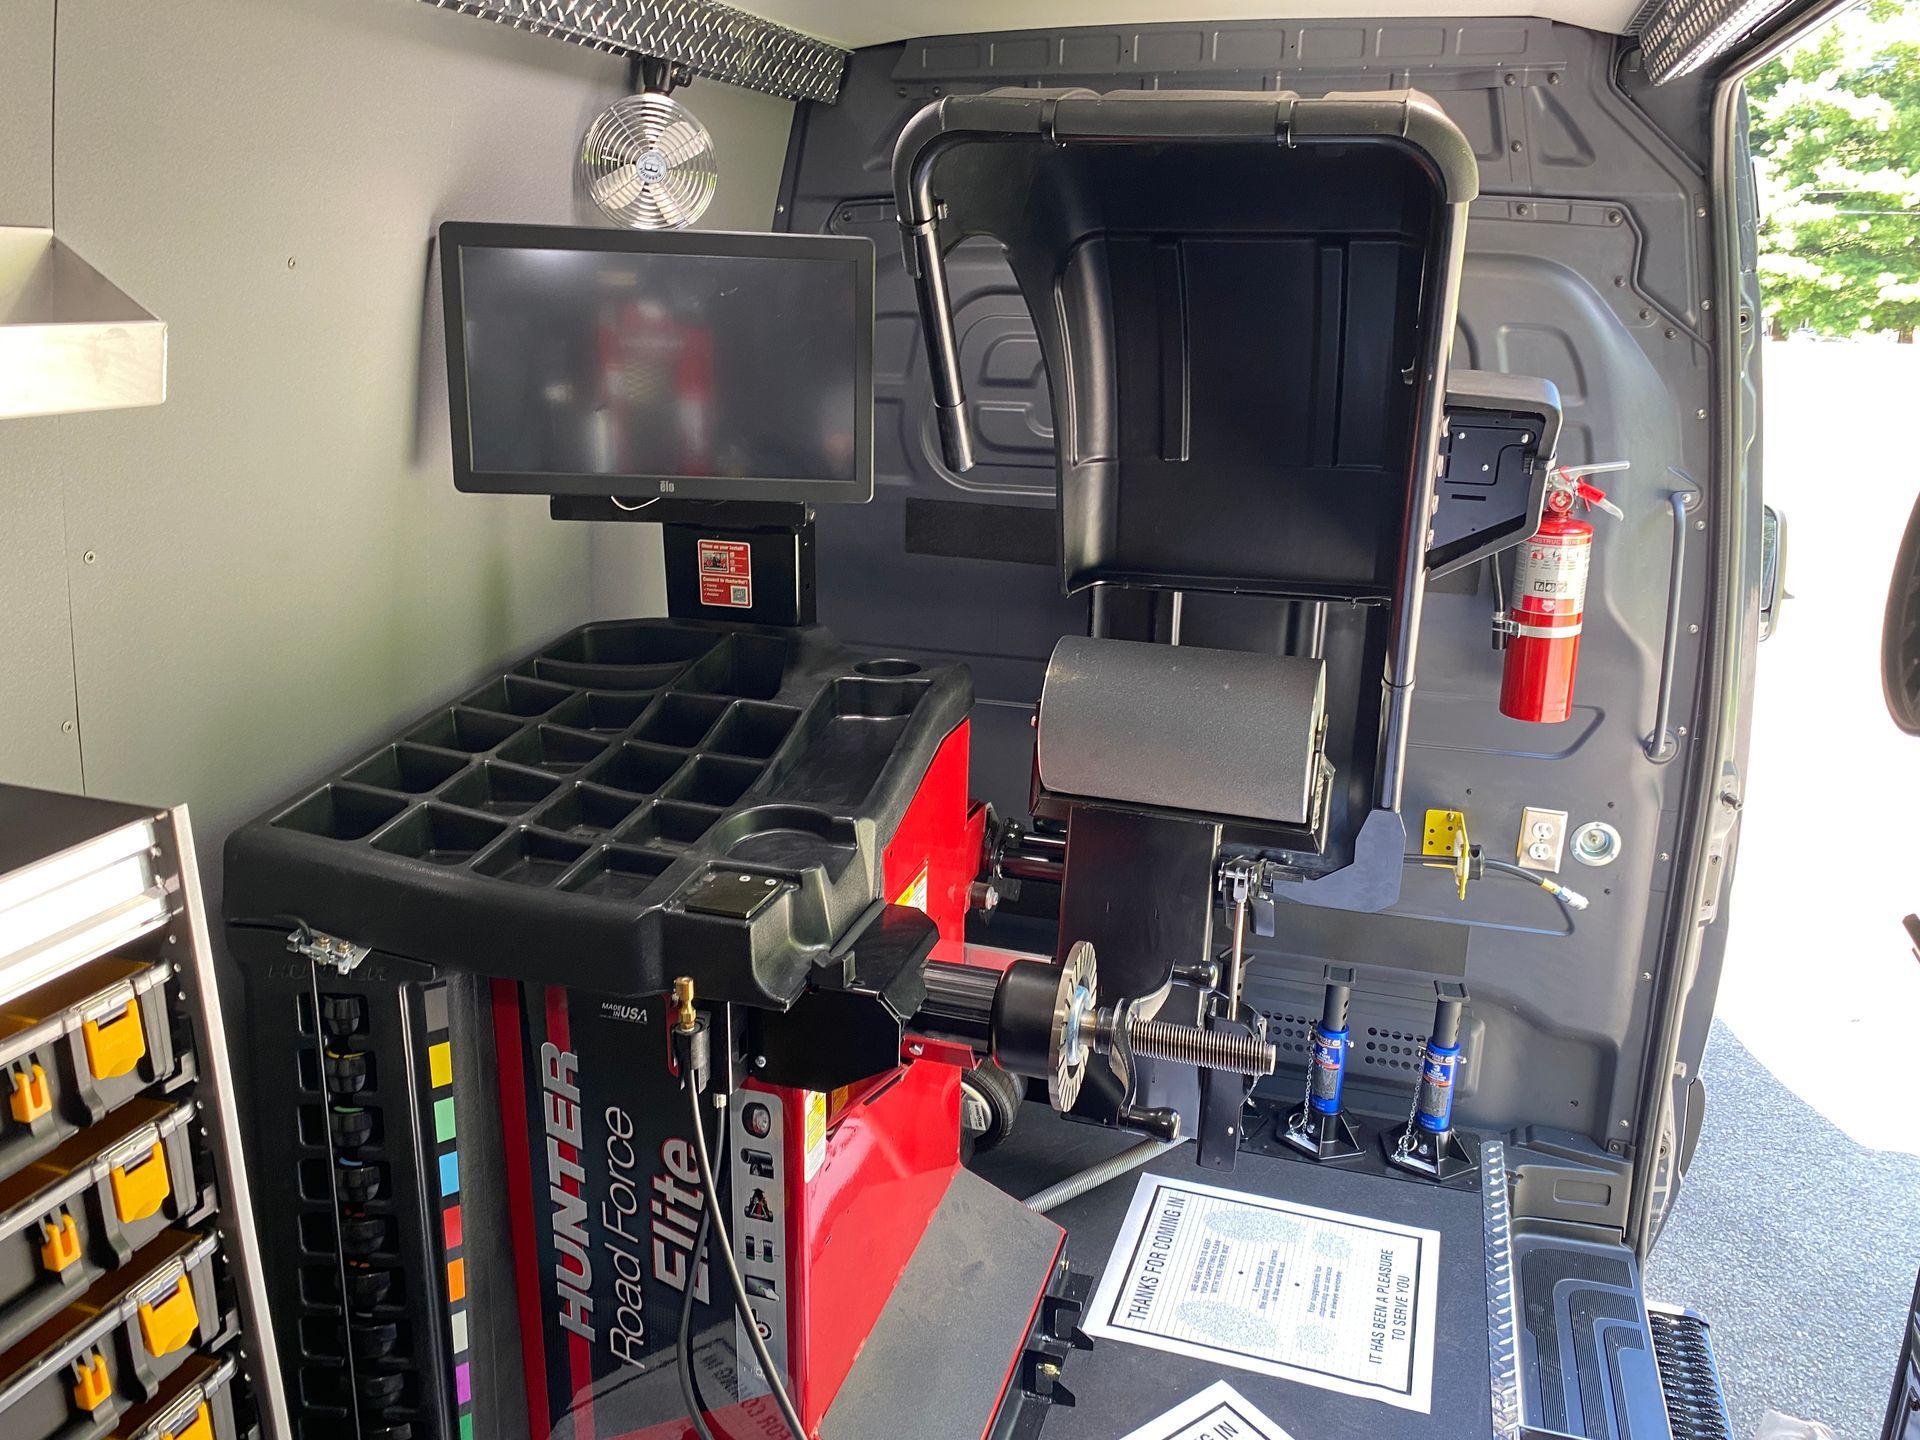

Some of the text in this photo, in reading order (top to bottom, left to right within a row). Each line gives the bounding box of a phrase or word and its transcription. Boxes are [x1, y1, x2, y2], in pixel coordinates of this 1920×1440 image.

[620, 1005, 648, 1022] USA
[541, 1041, 596, 1343] HUNTER
[601, 1105, 645, 1370] Road Force
[651, 1136, 710, 1305] Elite
[1127, 1195, 1186, 1320] THANKS FOR COMING IN
[1368, 1248, 1394, 1365] IT HAS BEEN A PLEASURE
[1391, 1274, 1410, 1341] TO SERVE YOU
[1212, 1420, 1239, 1439] IN
